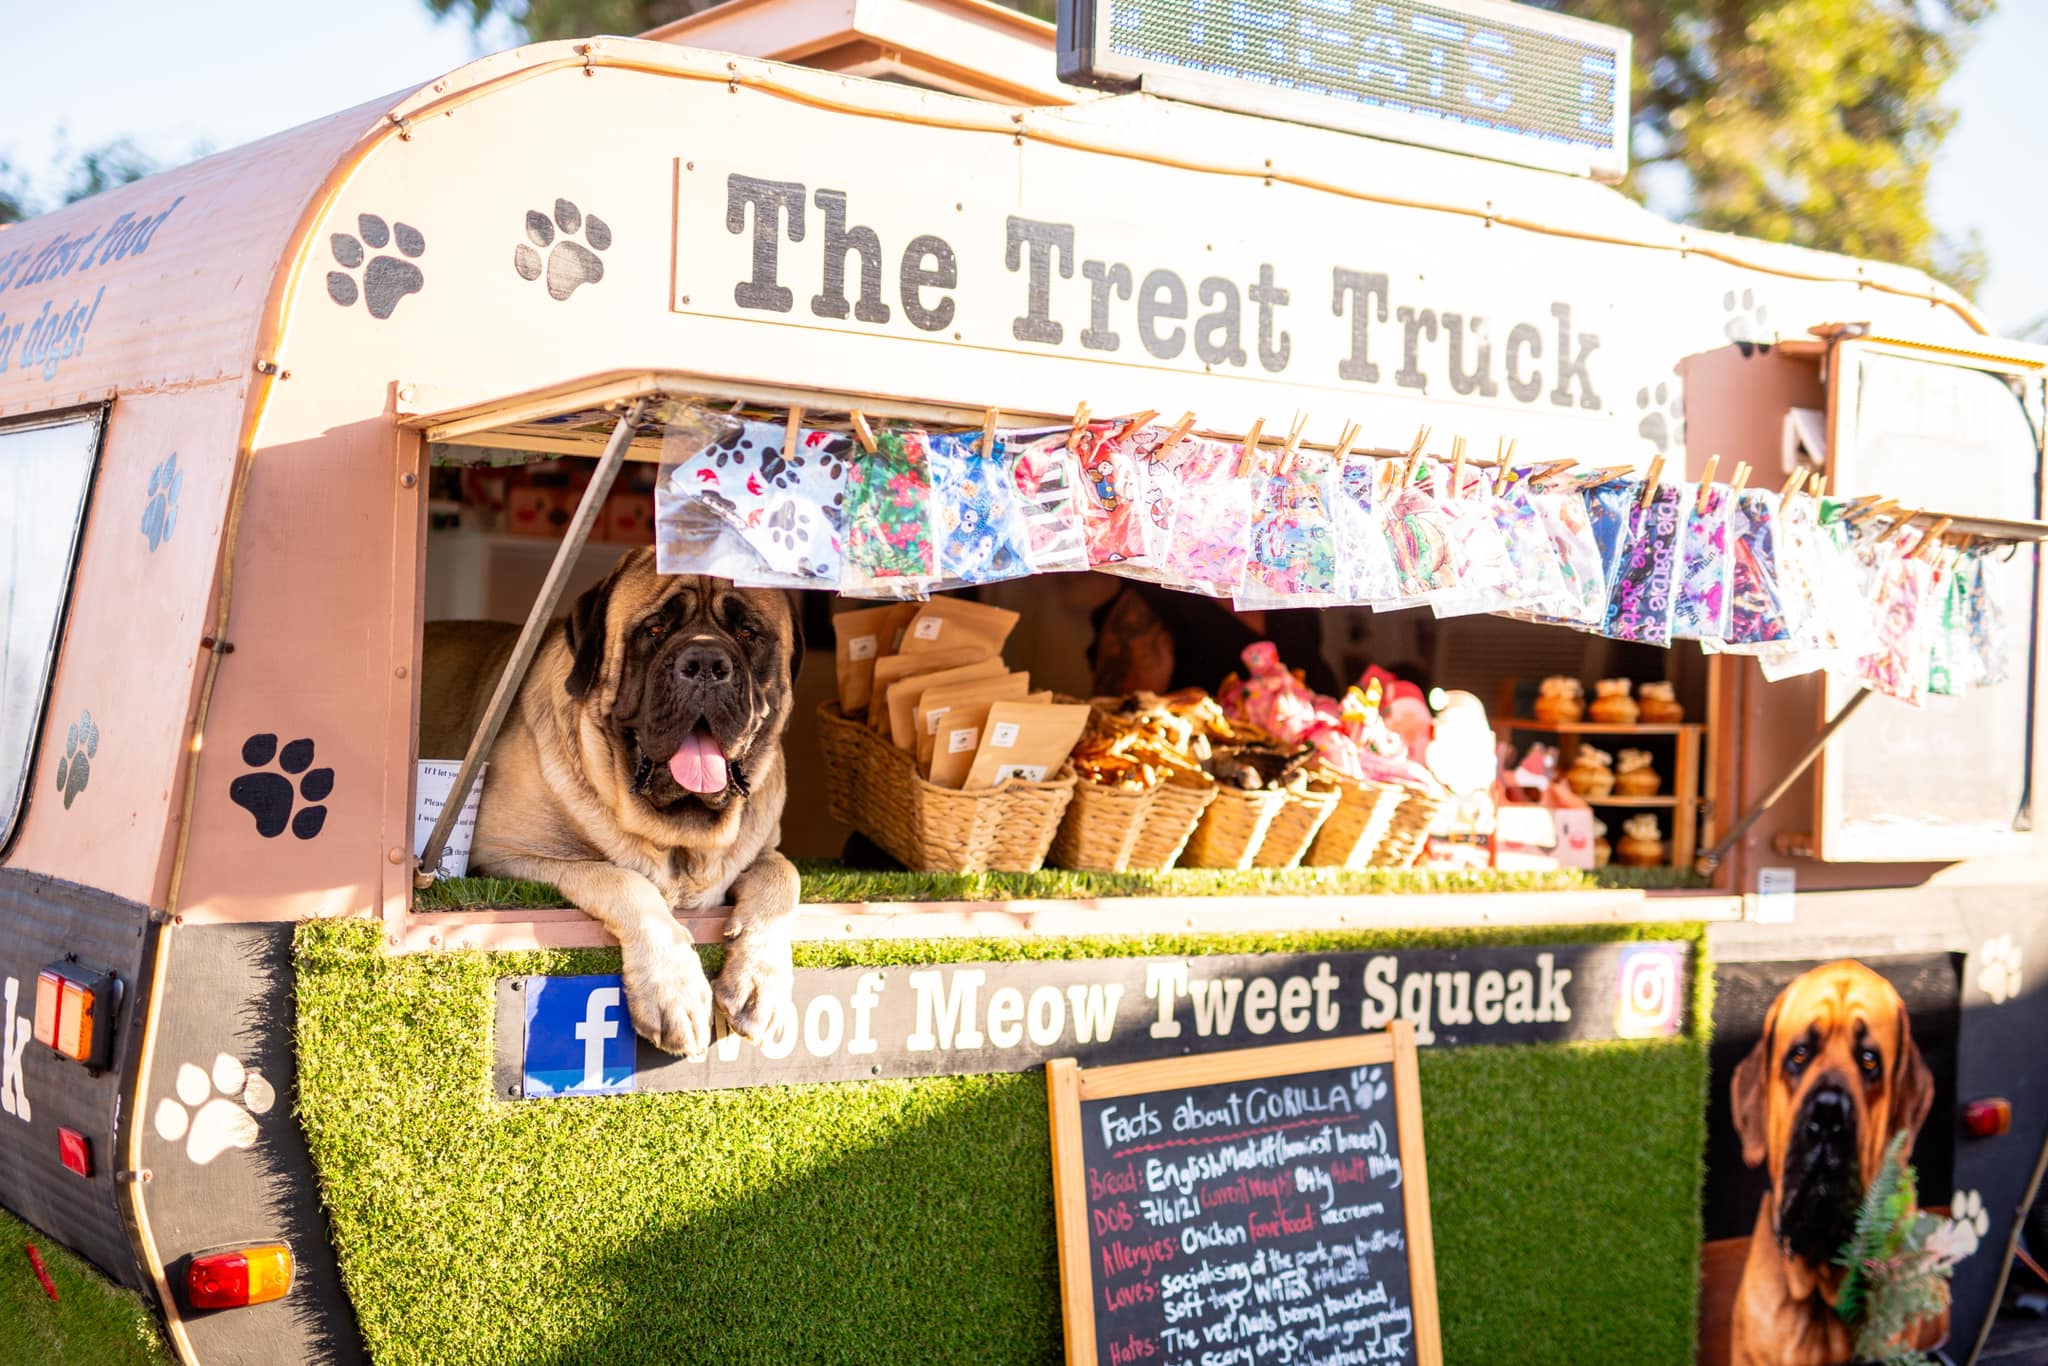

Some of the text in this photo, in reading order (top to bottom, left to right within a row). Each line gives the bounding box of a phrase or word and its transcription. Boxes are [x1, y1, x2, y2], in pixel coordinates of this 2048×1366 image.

[727, 172, 1601, 410] The Treat Truck
[688, 952, 1573, 1064] oof Meow Tweet Squeak
[1100, 1085, 1353, 1150] Facts about GORILLA
[1102, 1237, 1180, 1279] Allergies:
[1105, 1279, 1161, 1312] Loves:
[1160, 1326, 1200, 1354] The
